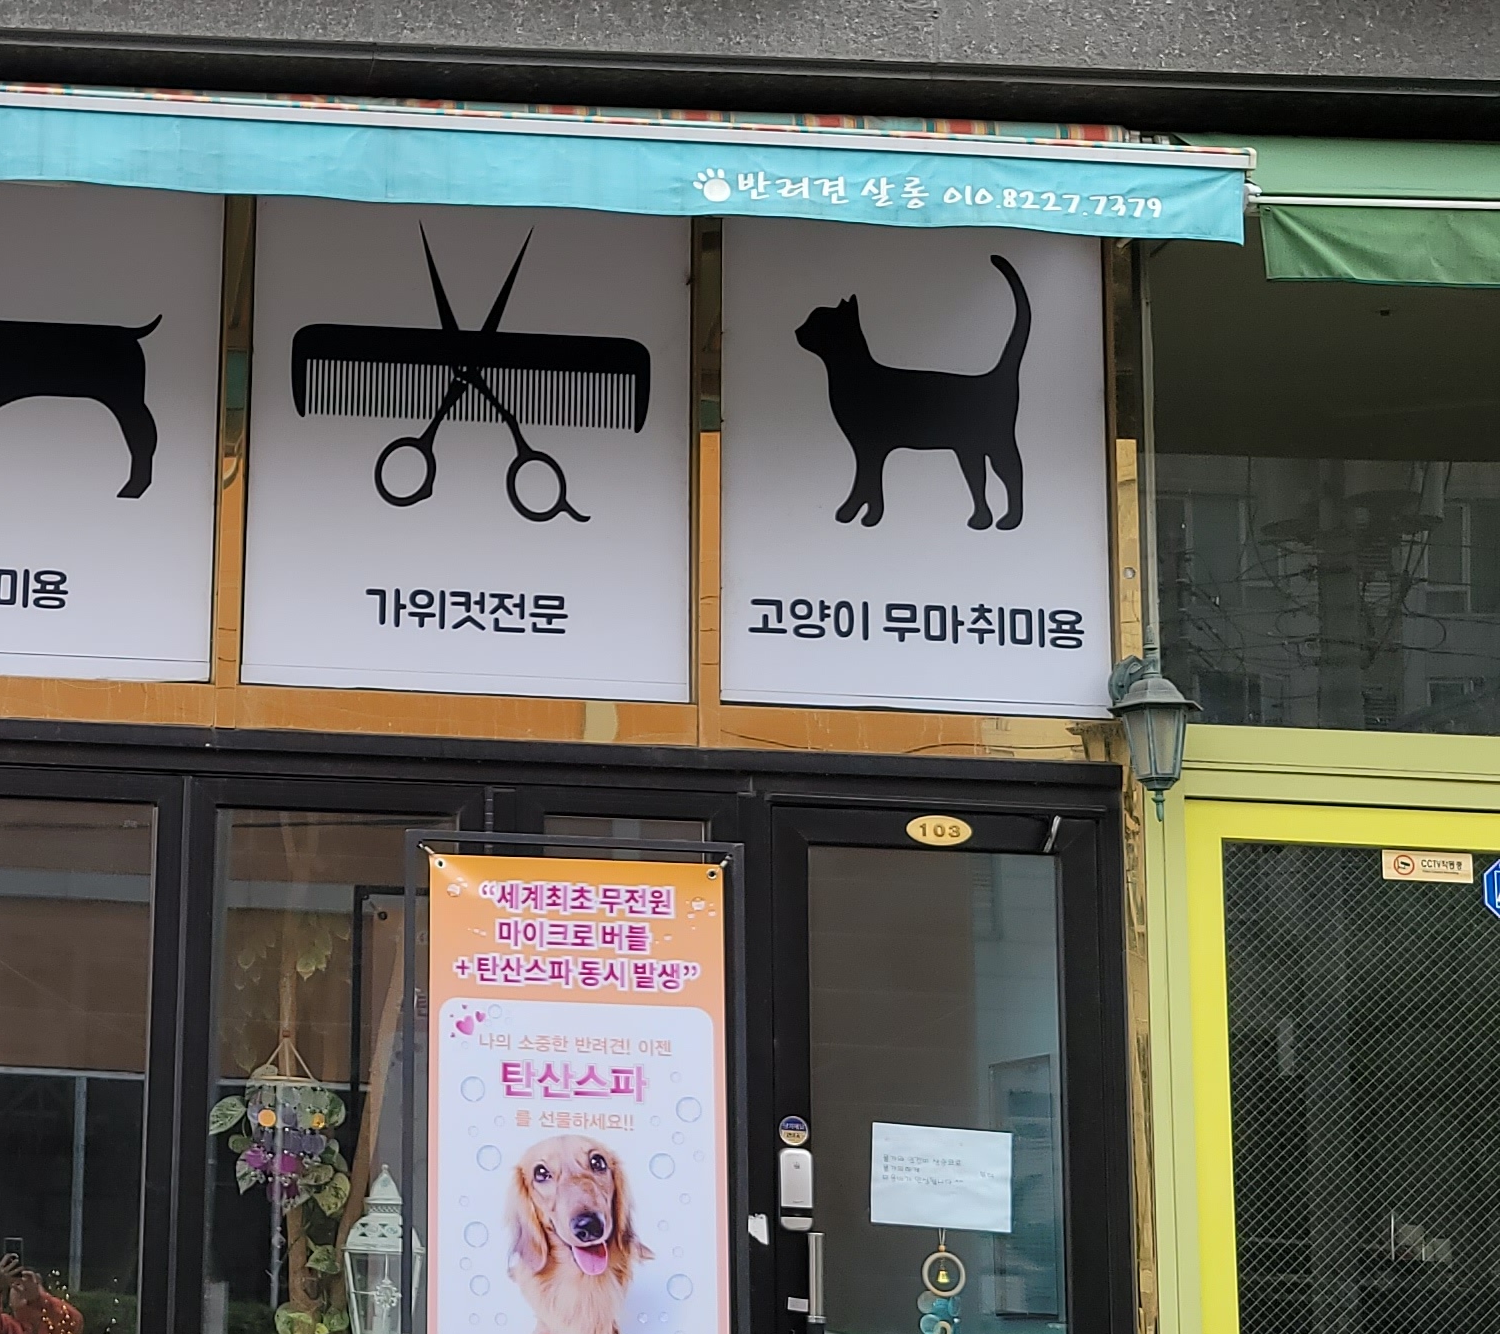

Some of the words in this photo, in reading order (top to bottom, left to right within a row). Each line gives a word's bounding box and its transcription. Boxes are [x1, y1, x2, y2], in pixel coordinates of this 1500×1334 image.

[738, 171, 846, 202] 반려견
[861, 175, 930, 210] 살롱
[365, 587, 569, 636] 가위컷전문
[748, 597, 870, 641] 고양이
[882, 603, 1085, 650] 무마취미용
[919, 823, 961, 838] 103
[598, 886, 673, 916] 무전원
[479, 1032, 512, 1051] 나의
[517, 1035, 569, 1053] 소중한
[574, 1036, 631, 1056] 반려견!
[637, 1039, 672, 1057] 이젠
[500, 1060, 648, 1104] 탄산스파
[515, 1109, 532, 1128] 를
[538, 1110, 635, 1132] 선물하세요!!
